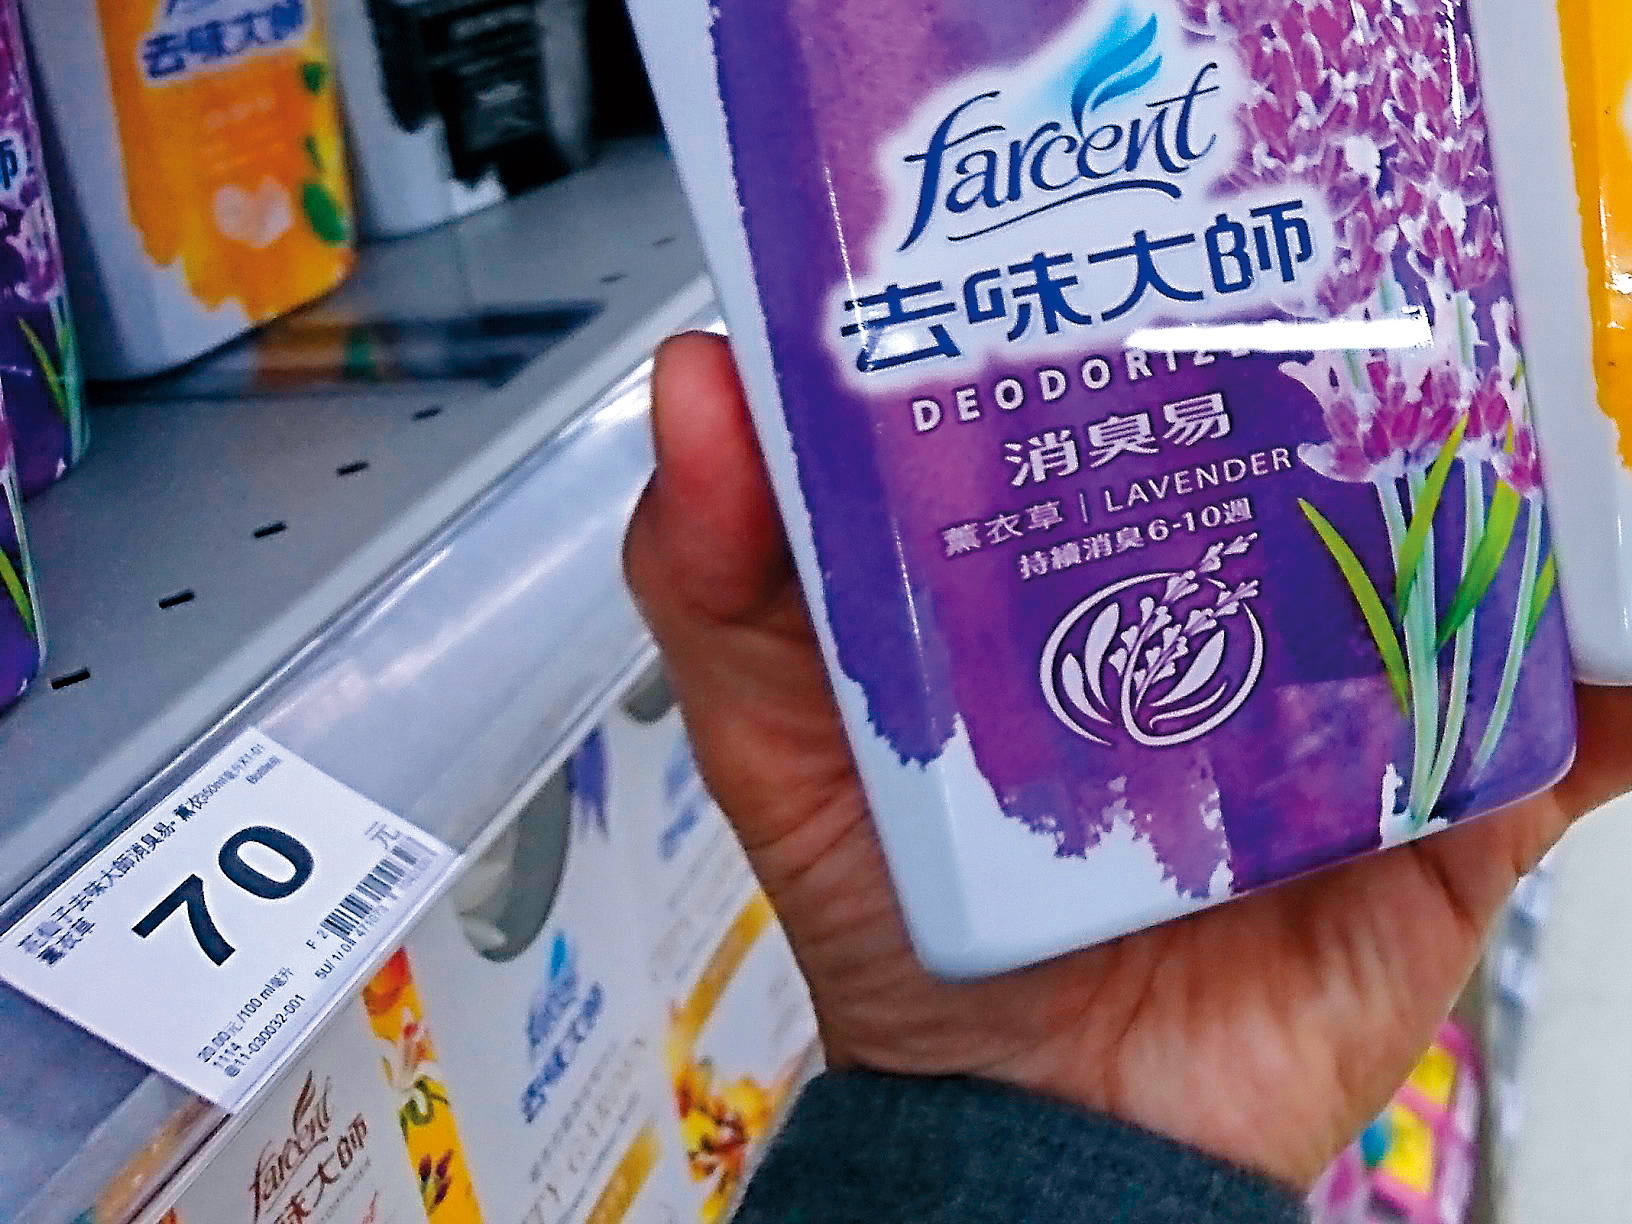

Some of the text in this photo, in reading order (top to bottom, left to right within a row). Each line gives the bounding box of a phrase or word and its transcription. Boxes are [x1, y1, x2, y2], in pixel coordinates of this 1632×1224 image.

[897, 61, 1221, 253] farcent
[840, 199, 1313, 373] 去味大師
[910, 348, 1252, 434] DEODORIZ
[1004, 391, 1234, 487] 消臭易
[1105, 447, 1293, 514] LAVENDER
[1017, 496, 1253, 580] 持續消臭6-10週
[364, 821, 402, 850] 元
[132, 824, 316, 967] 70
